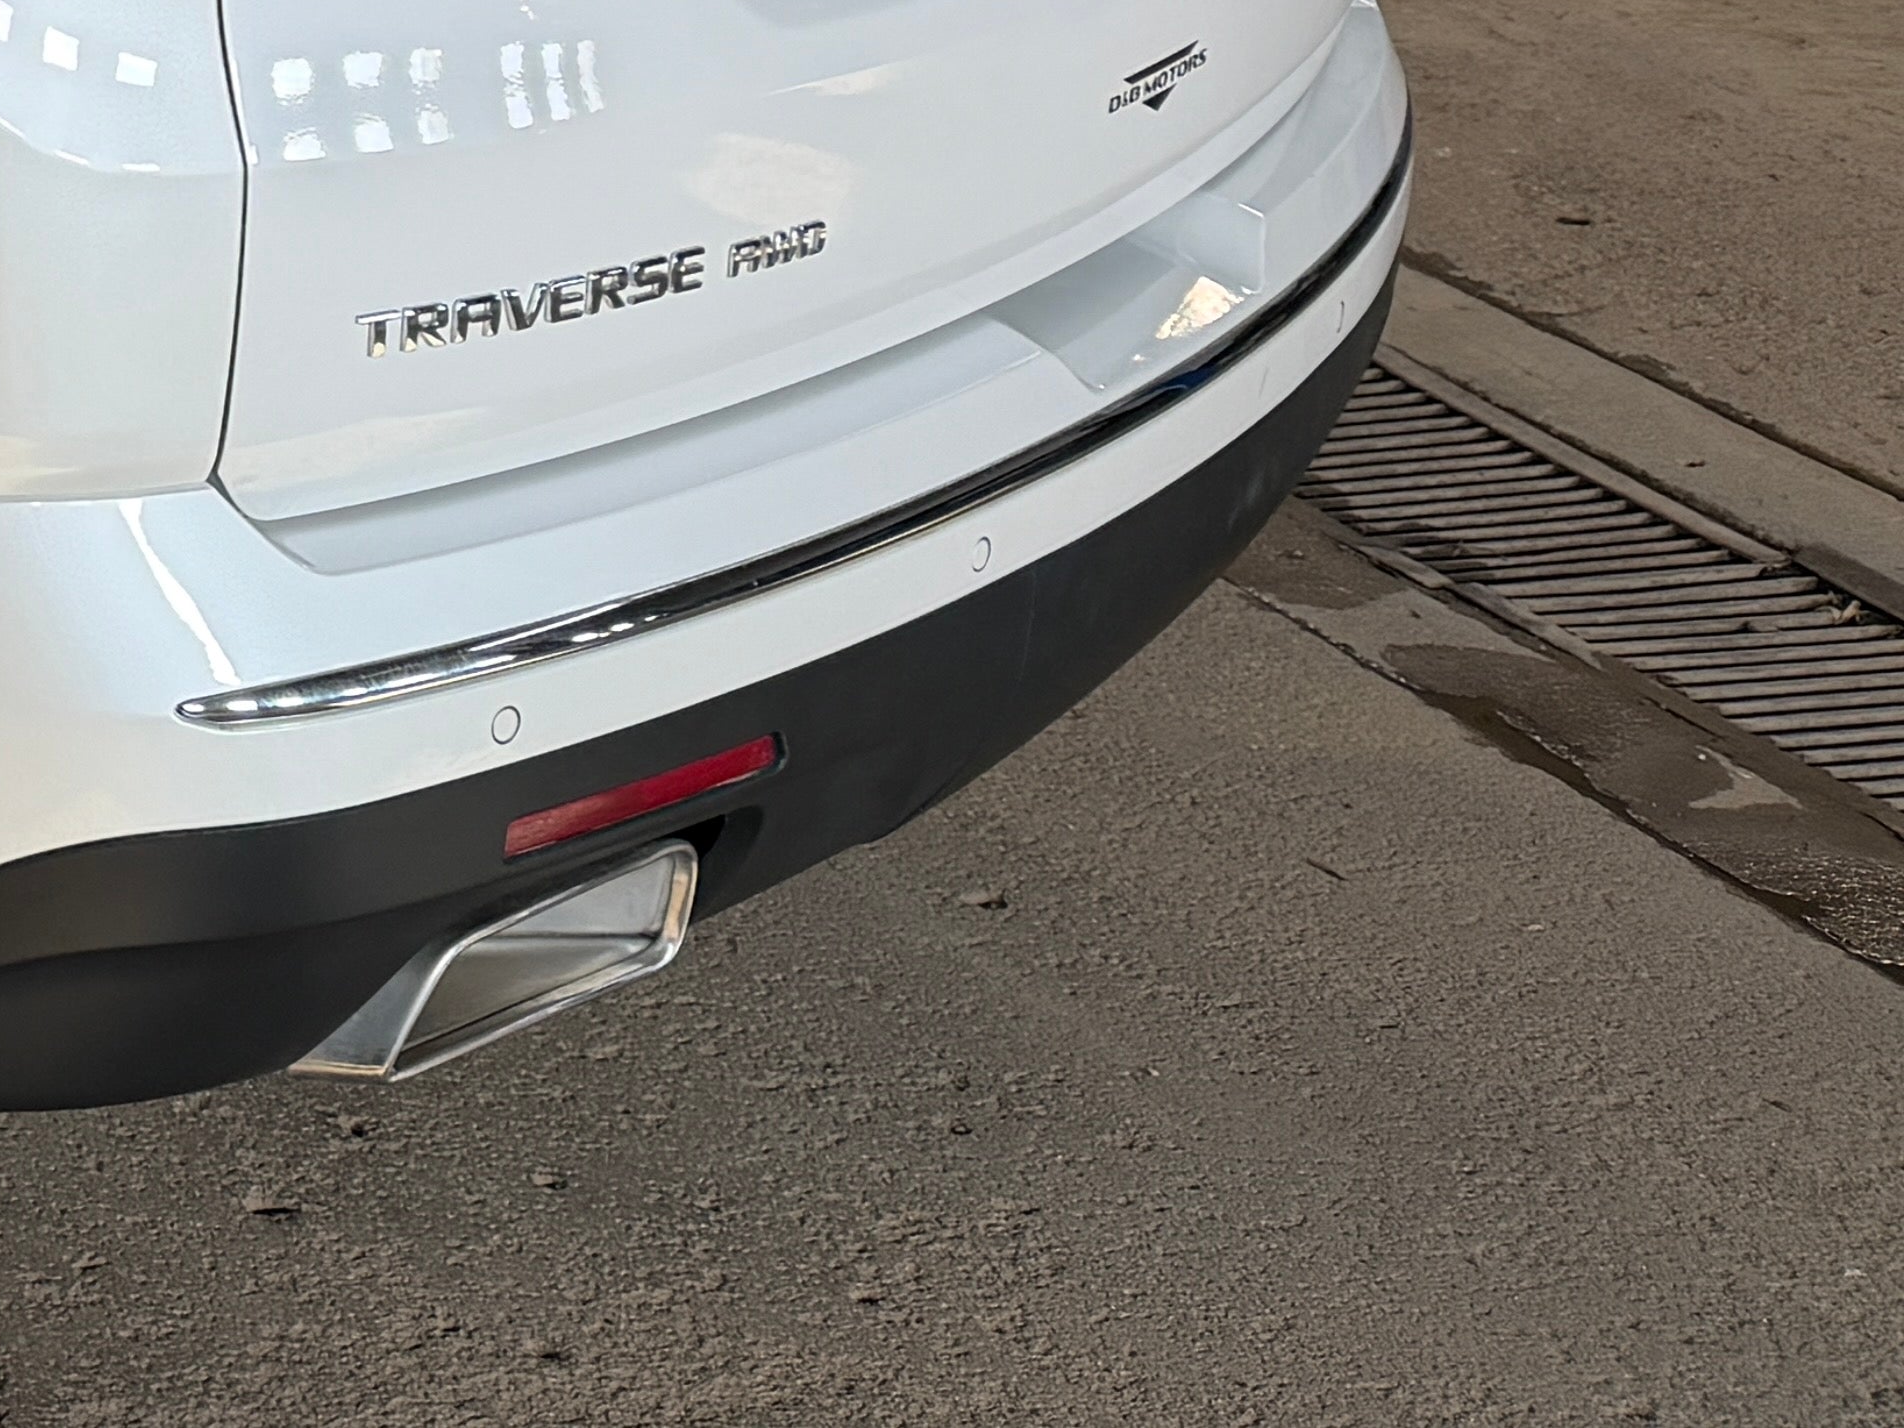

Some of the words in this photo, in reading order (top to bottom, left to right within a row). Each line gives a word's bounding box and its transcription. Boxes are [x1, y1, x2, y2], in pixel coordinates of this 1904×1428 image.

[1143, 47, 1208, 96] MOTORS
[354, 245, 706, 359] TRAVERSE
[726, 219, 827, 279] AWD
